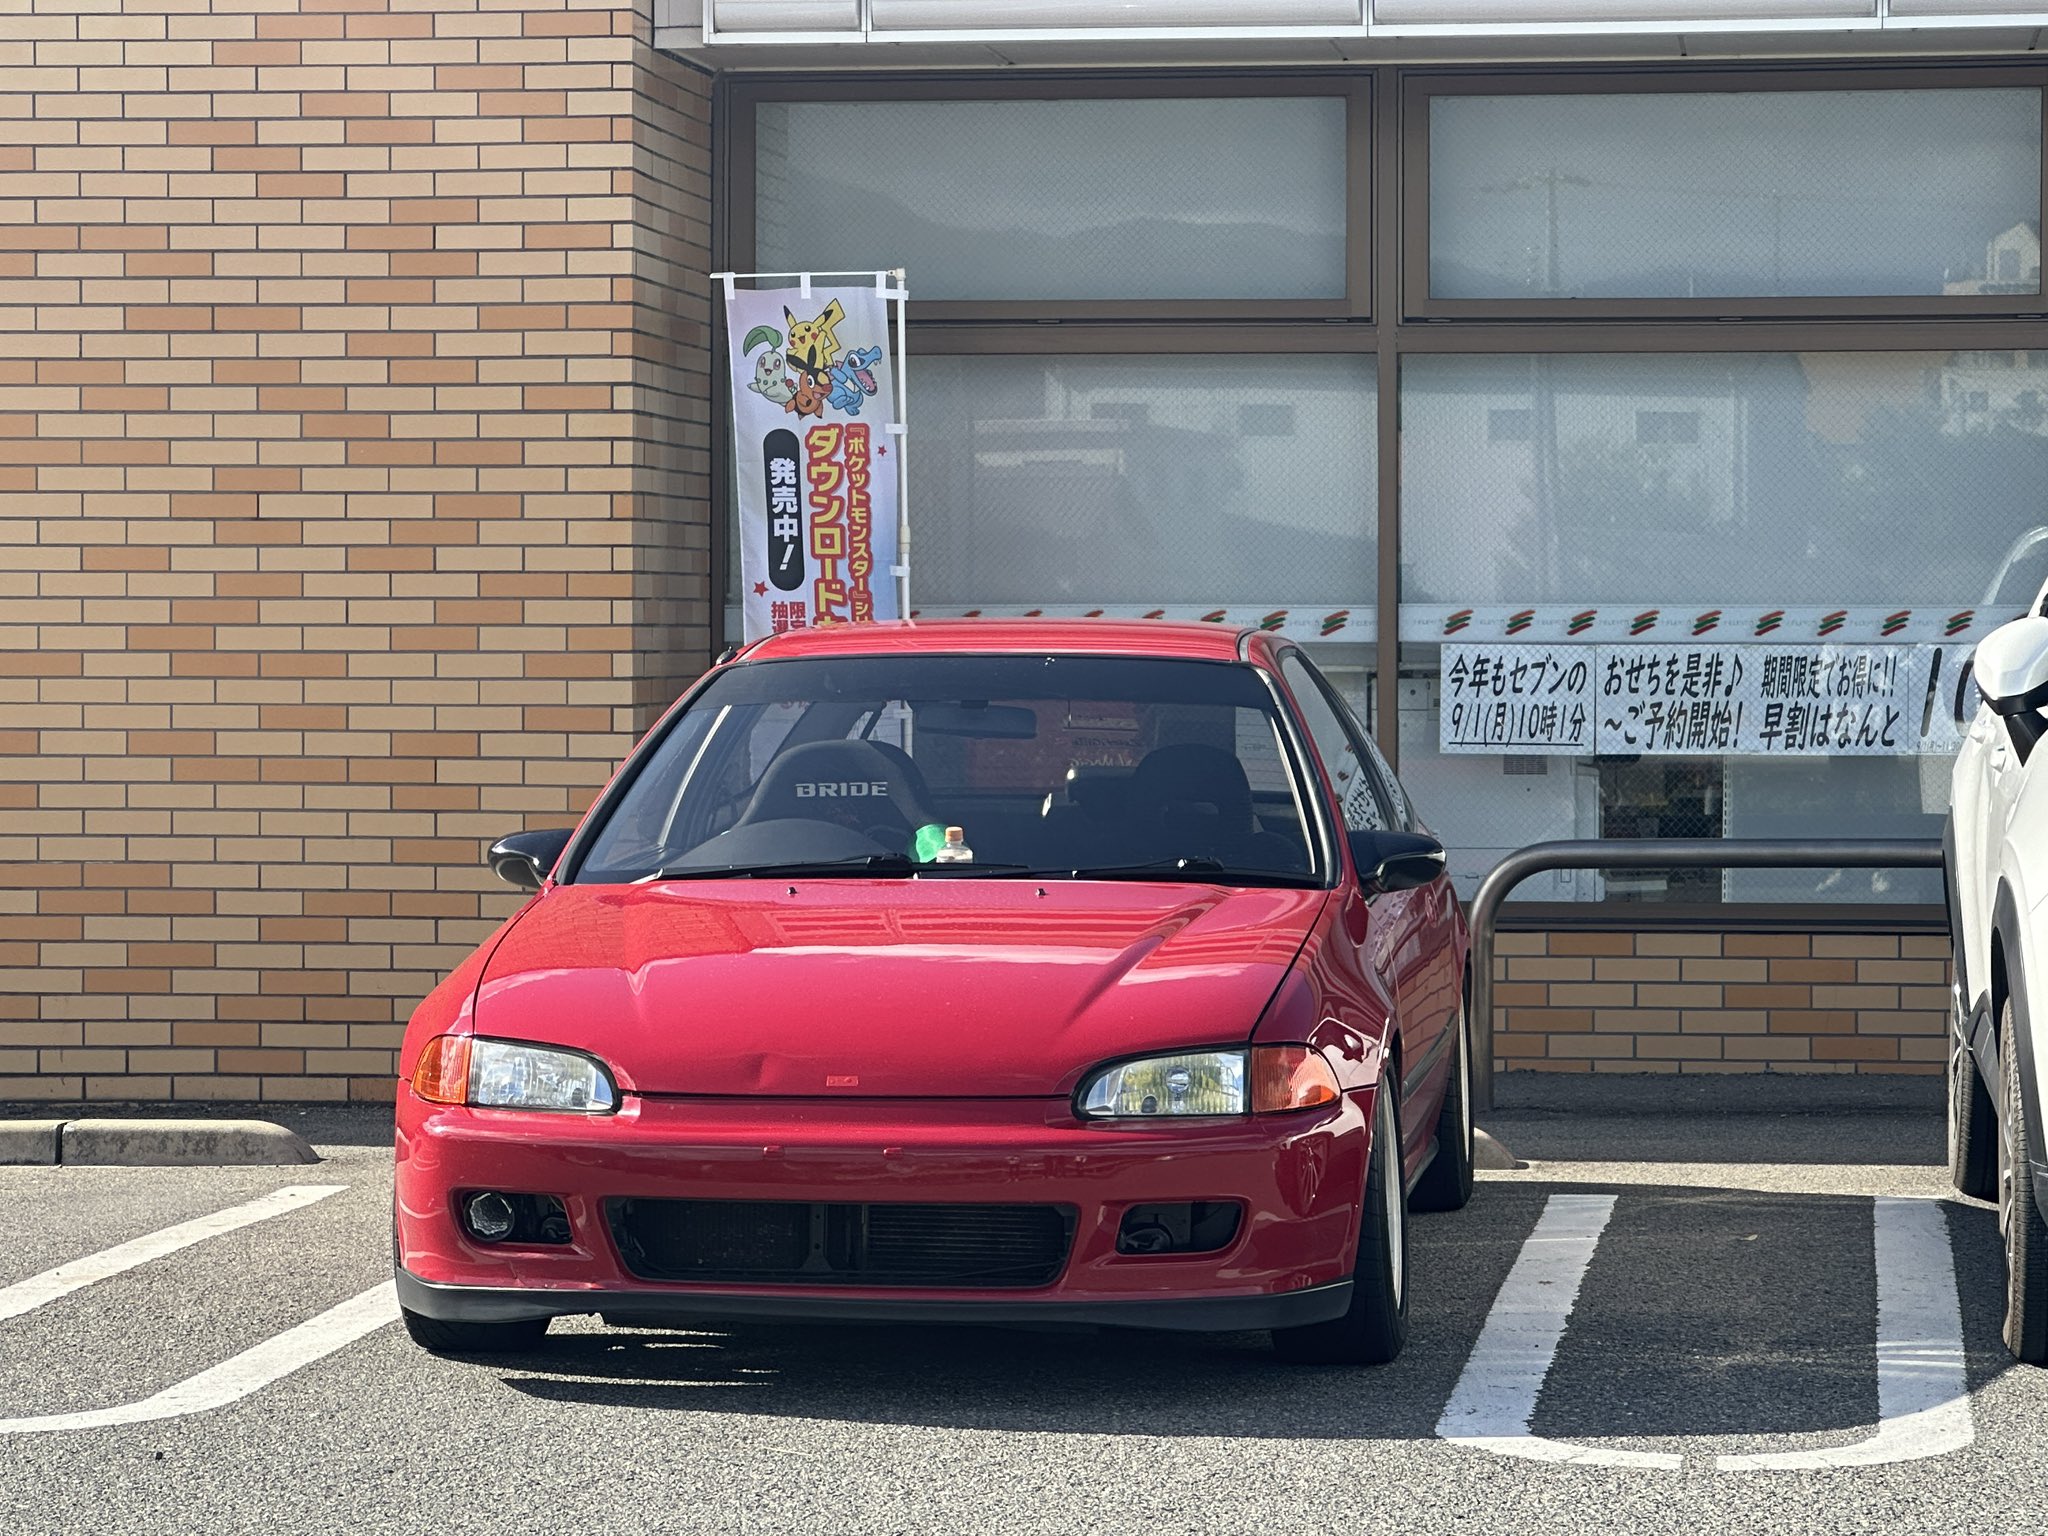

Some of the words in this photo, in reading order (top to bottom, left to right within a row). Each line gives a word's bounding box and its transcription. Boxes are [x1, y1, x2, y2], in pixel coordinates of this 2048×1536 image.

[769, 458, 799, 571] 発売中!
[1449, 654, 1587, 698] 今年もセブンの
[1452, 702, 1586, 746] 9/1(月)10時1分
[1760, 702, 1899, 749] 早割はなんと
[795, 781, 888, 798] BRIDE
